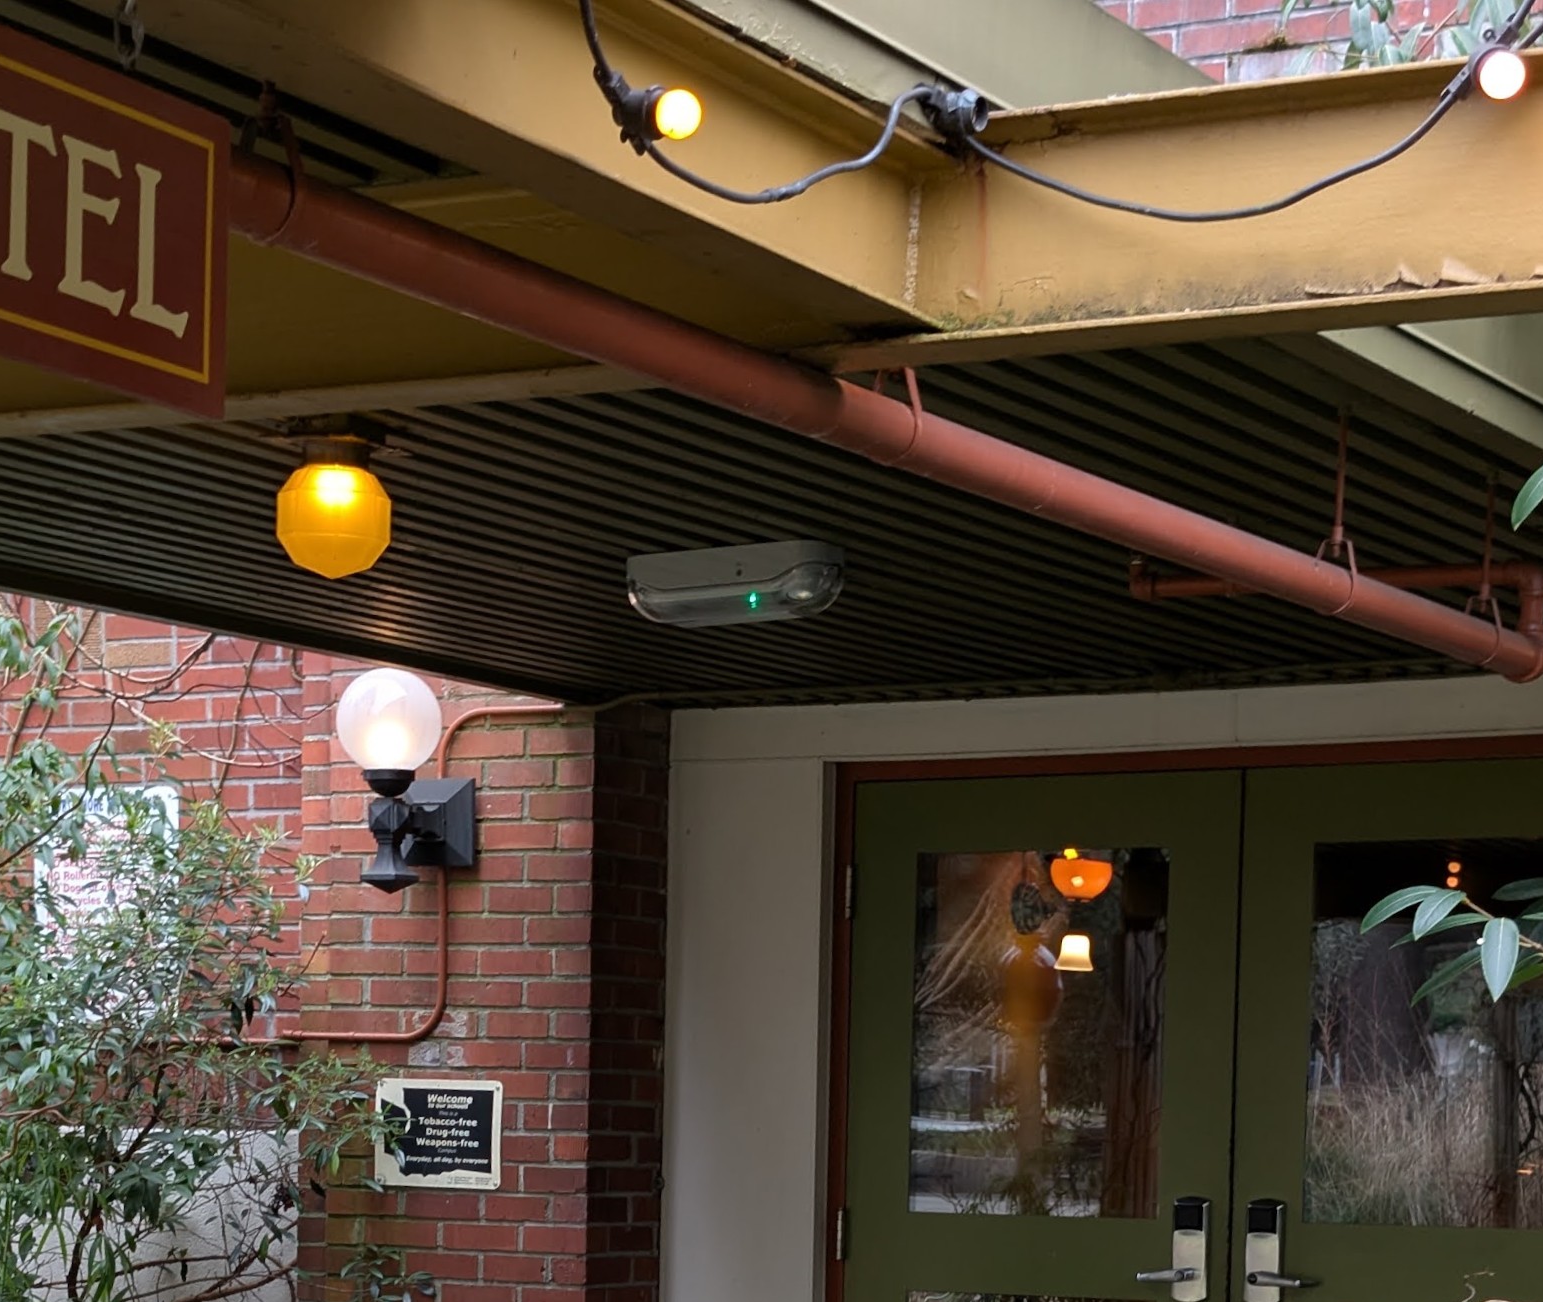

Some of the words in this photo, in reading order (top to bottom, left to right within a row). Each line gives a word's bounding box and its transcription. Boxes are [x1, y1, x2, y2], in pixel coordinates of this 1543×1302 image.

[427, 1094, 473, 1105] Welcome
[418, 1117, 478, 1127] Tobacco-free
[426, 1128, 470, 1137] Drug-free
[416, 1138, 479, 1148] Weapons-free
